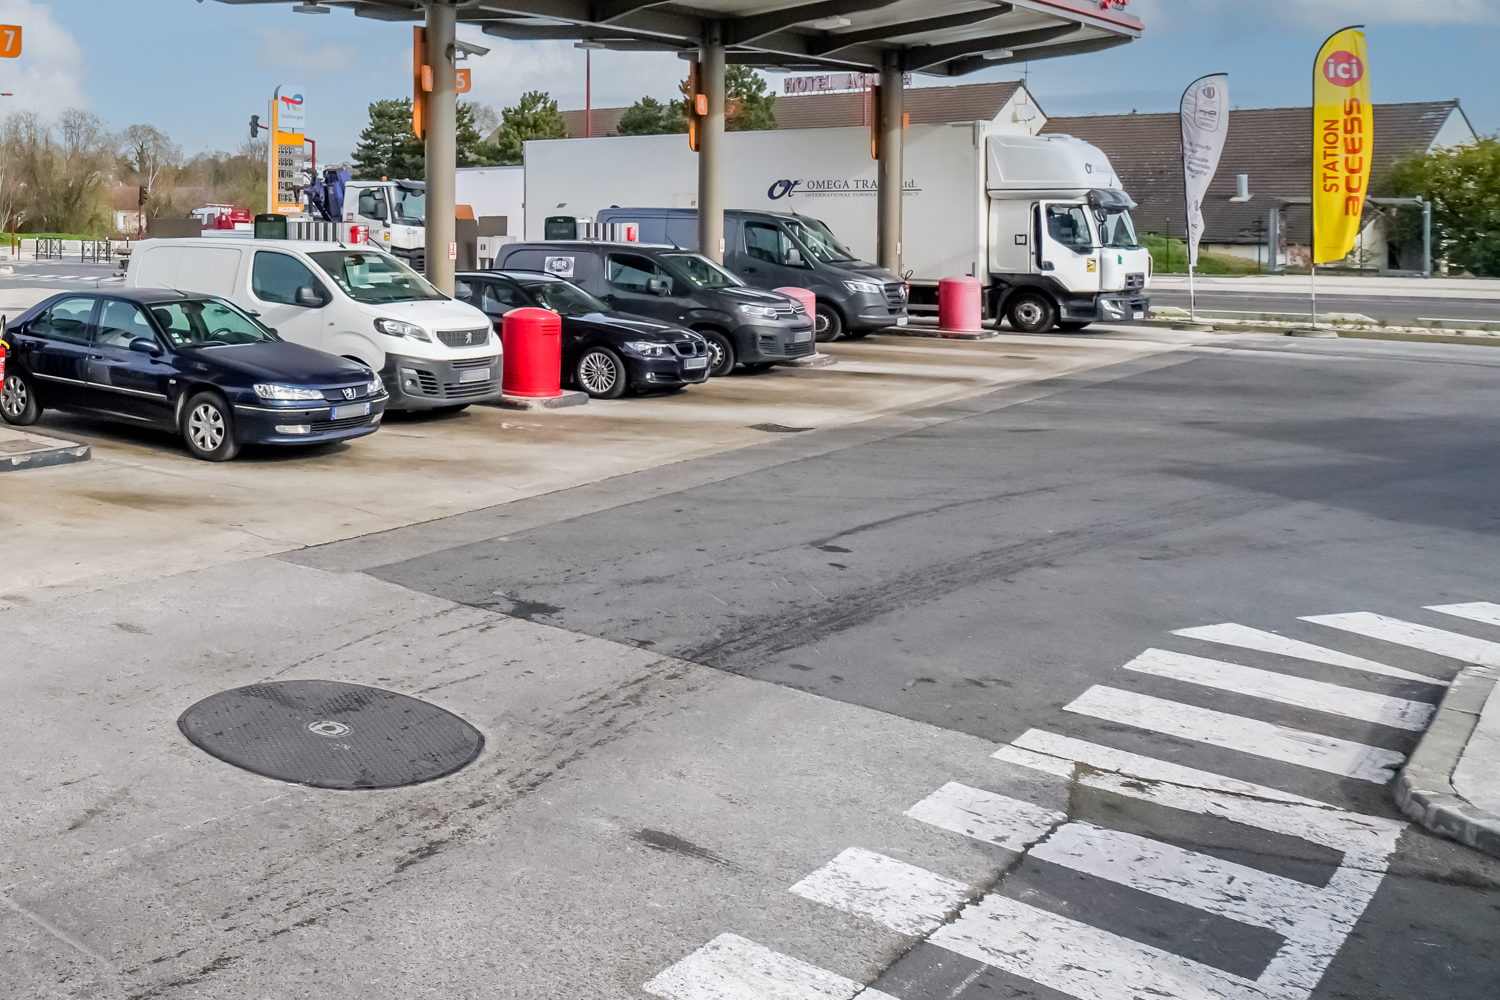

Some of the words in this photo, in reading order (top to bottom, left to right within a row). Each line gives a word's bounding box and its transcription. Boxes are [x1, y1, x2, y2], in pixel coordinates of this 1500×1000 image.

[3, 30, 15, 52] 7
[1328, 58, 1359, 79] ici
[456, 72, 466, 89] 5
[784, 75, 833, 93] HOTEL
[699, 98, 705, 112] 4
[1323, 119, 1340, 193] STATION
[806, 179, 850, 190] OMEGA
[902, 179, 918, 188] td.
[552, 260, 567, 268] SER
